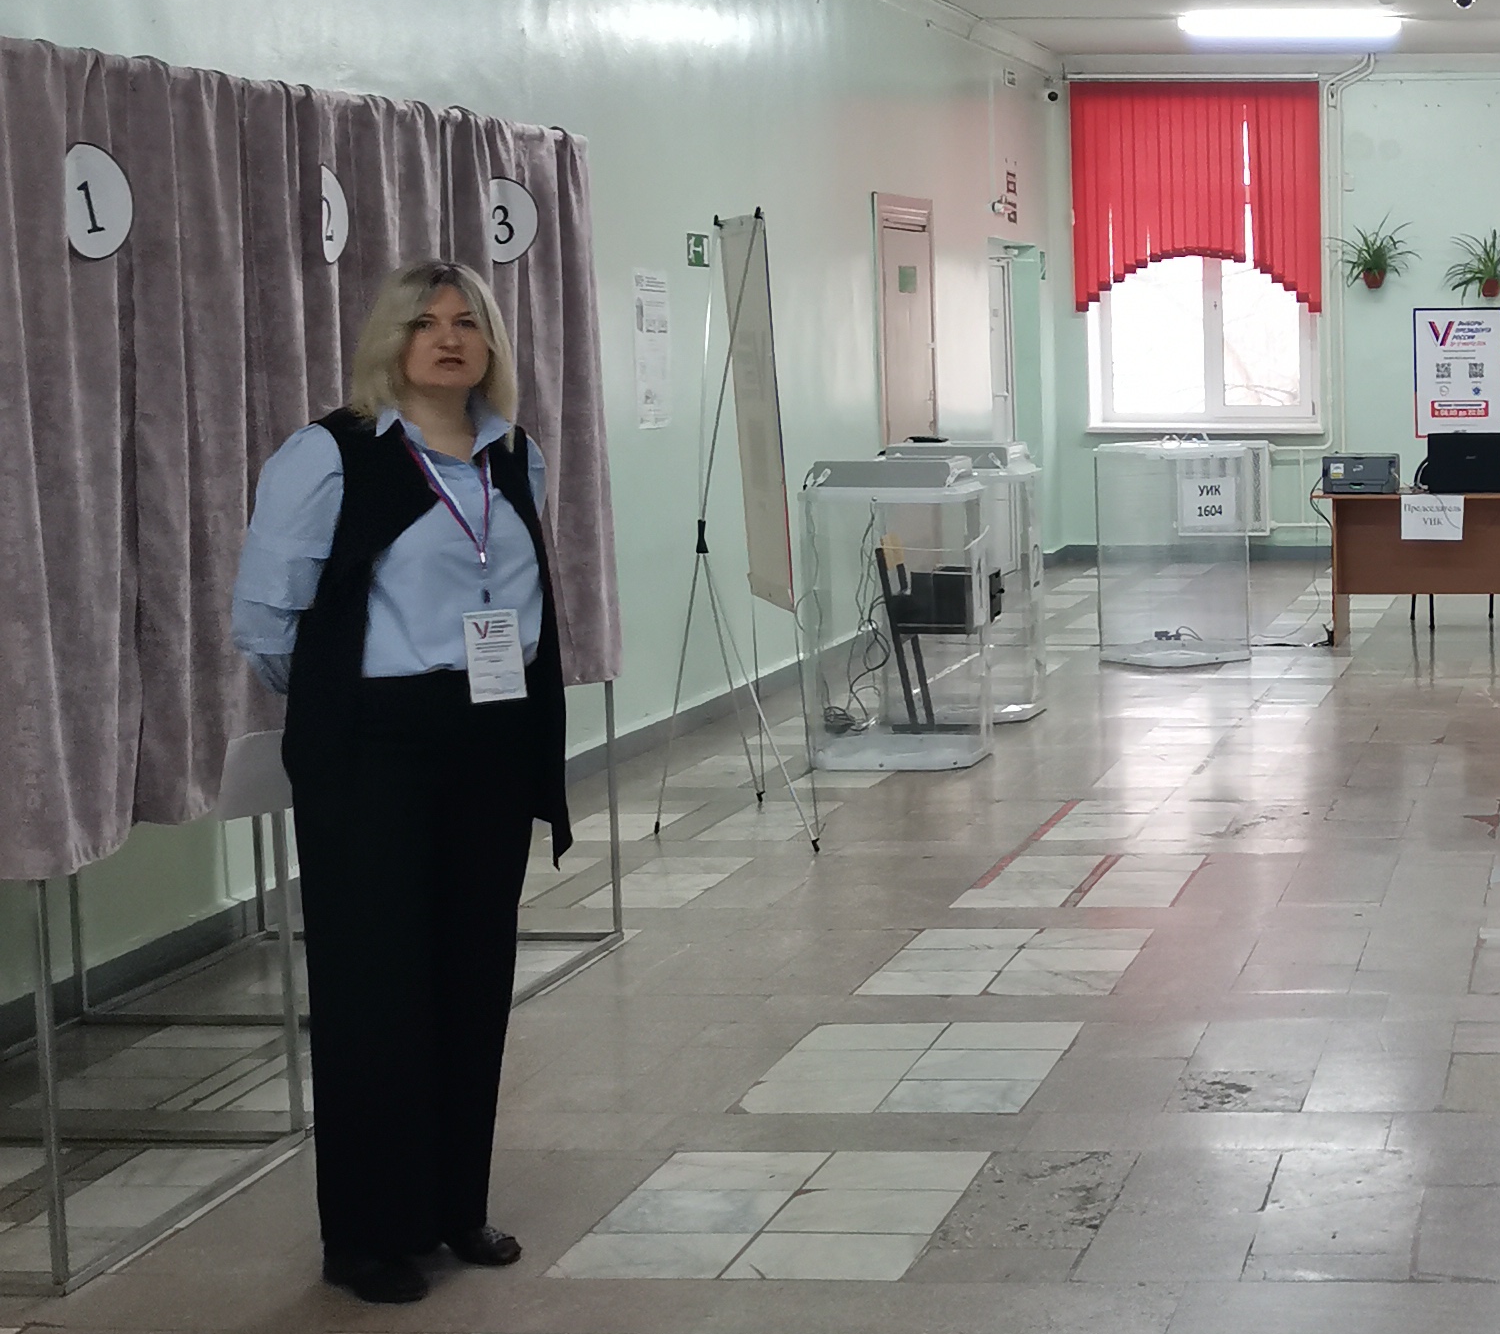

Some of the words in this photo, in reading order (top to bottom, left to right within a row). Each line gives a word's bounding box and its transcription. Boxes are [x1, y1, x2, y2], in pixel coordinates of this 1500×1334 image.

[76, 180, 105, 234] 1
[491, 204, 515, 245] 3
[1198, 485, 1222, 497] УИК
[1197, 504, 1223, 517] 1604
